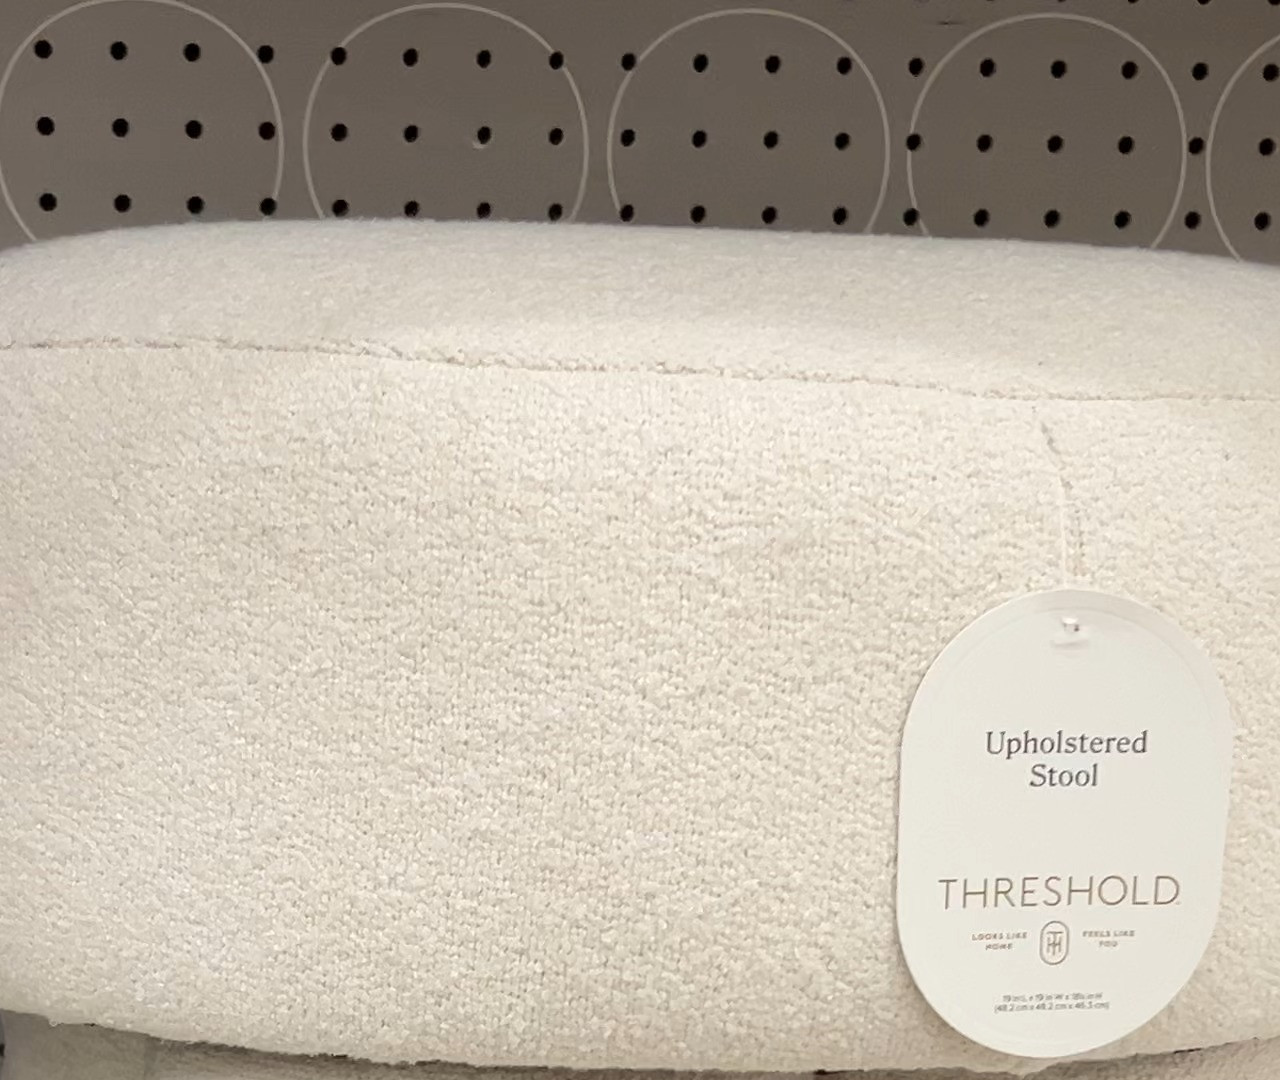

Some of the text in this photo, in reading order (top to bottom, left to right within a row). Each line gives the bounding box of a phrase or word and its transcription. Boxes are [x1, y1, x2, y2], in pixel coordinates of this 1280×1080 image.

[985, 729, 1149, 760] Upholstered
[1028, 762, 1099, 788] Stool
[937, 874, 1182, 911] THRESHOLD
